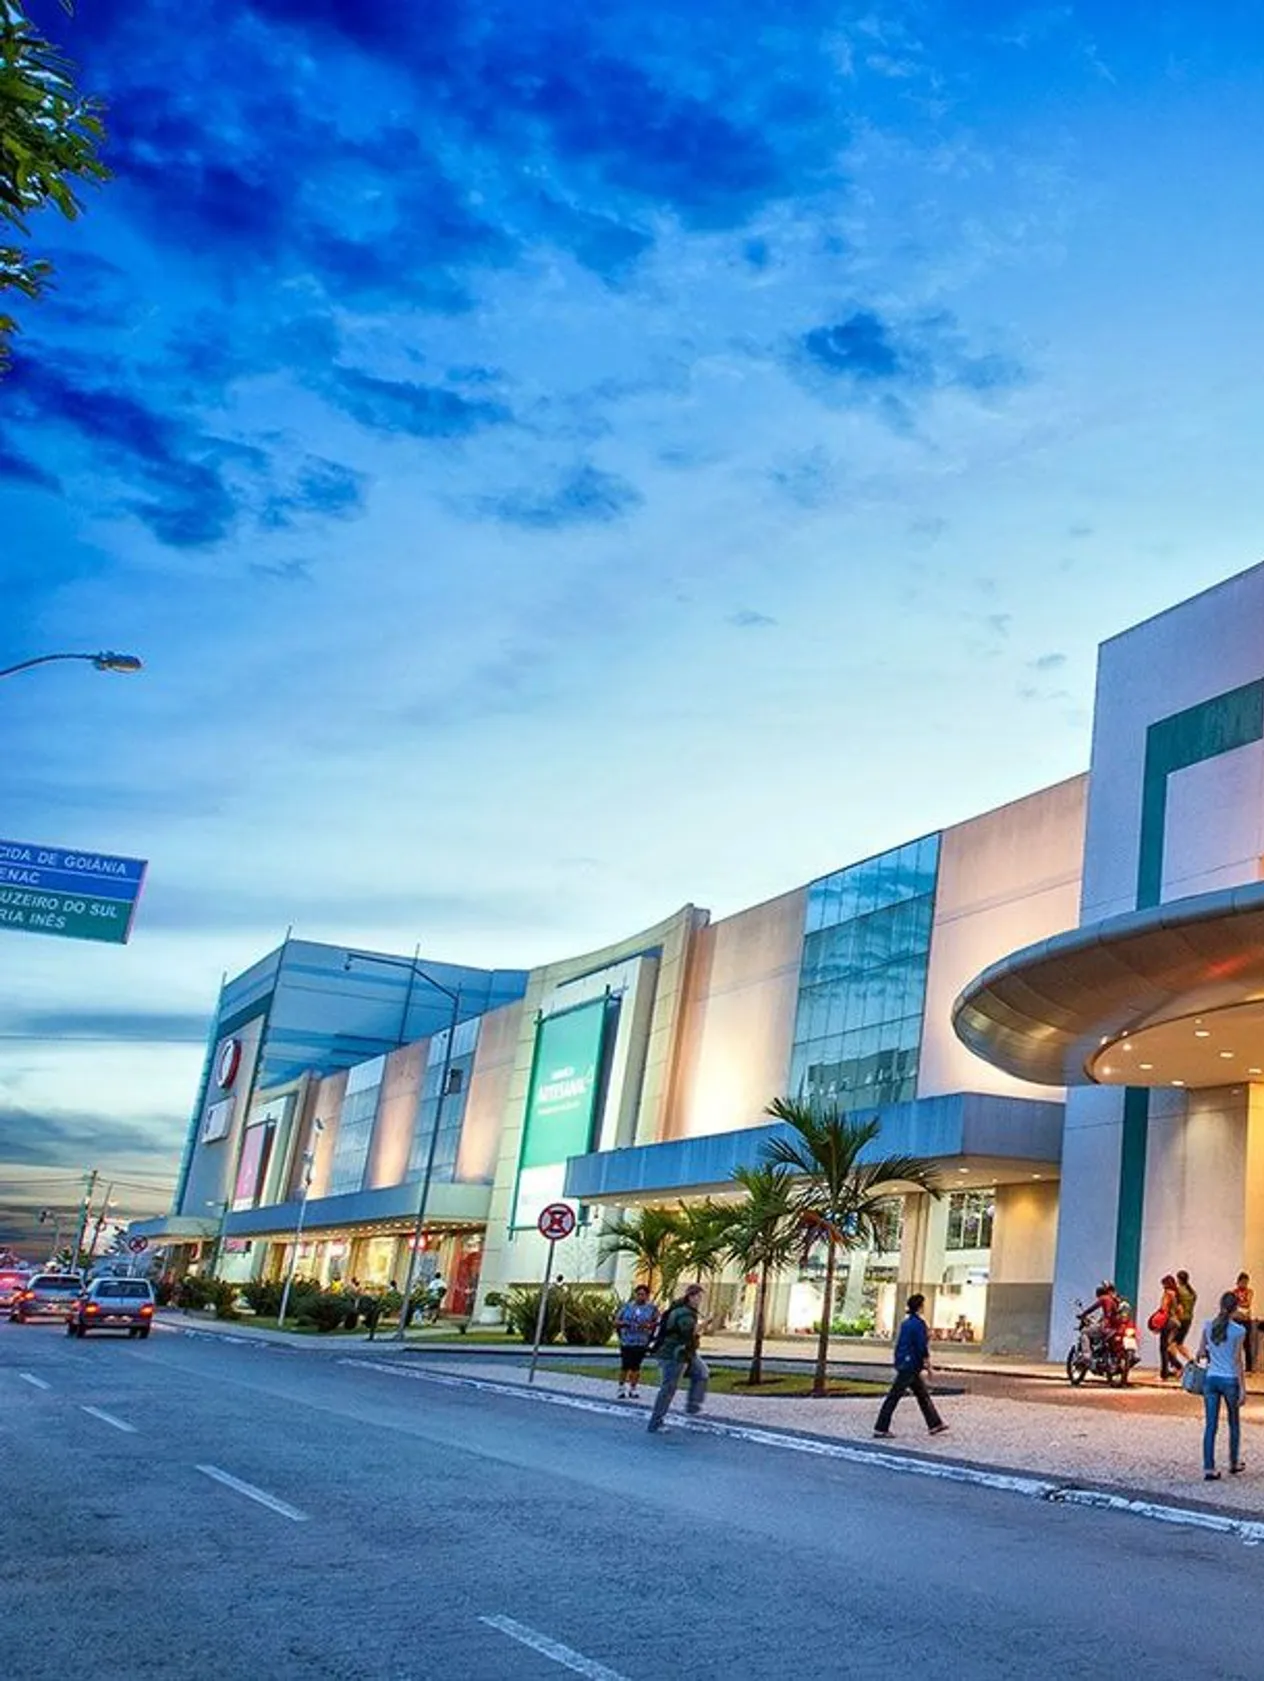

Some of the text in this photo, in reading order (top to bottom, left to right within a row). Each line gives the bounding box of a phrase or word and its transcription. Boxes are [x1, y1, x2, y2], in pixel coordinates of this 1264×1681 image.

[37, 851, 58, 866] DE
[0, 890, 118, 919] UZEIRO DO SUL
